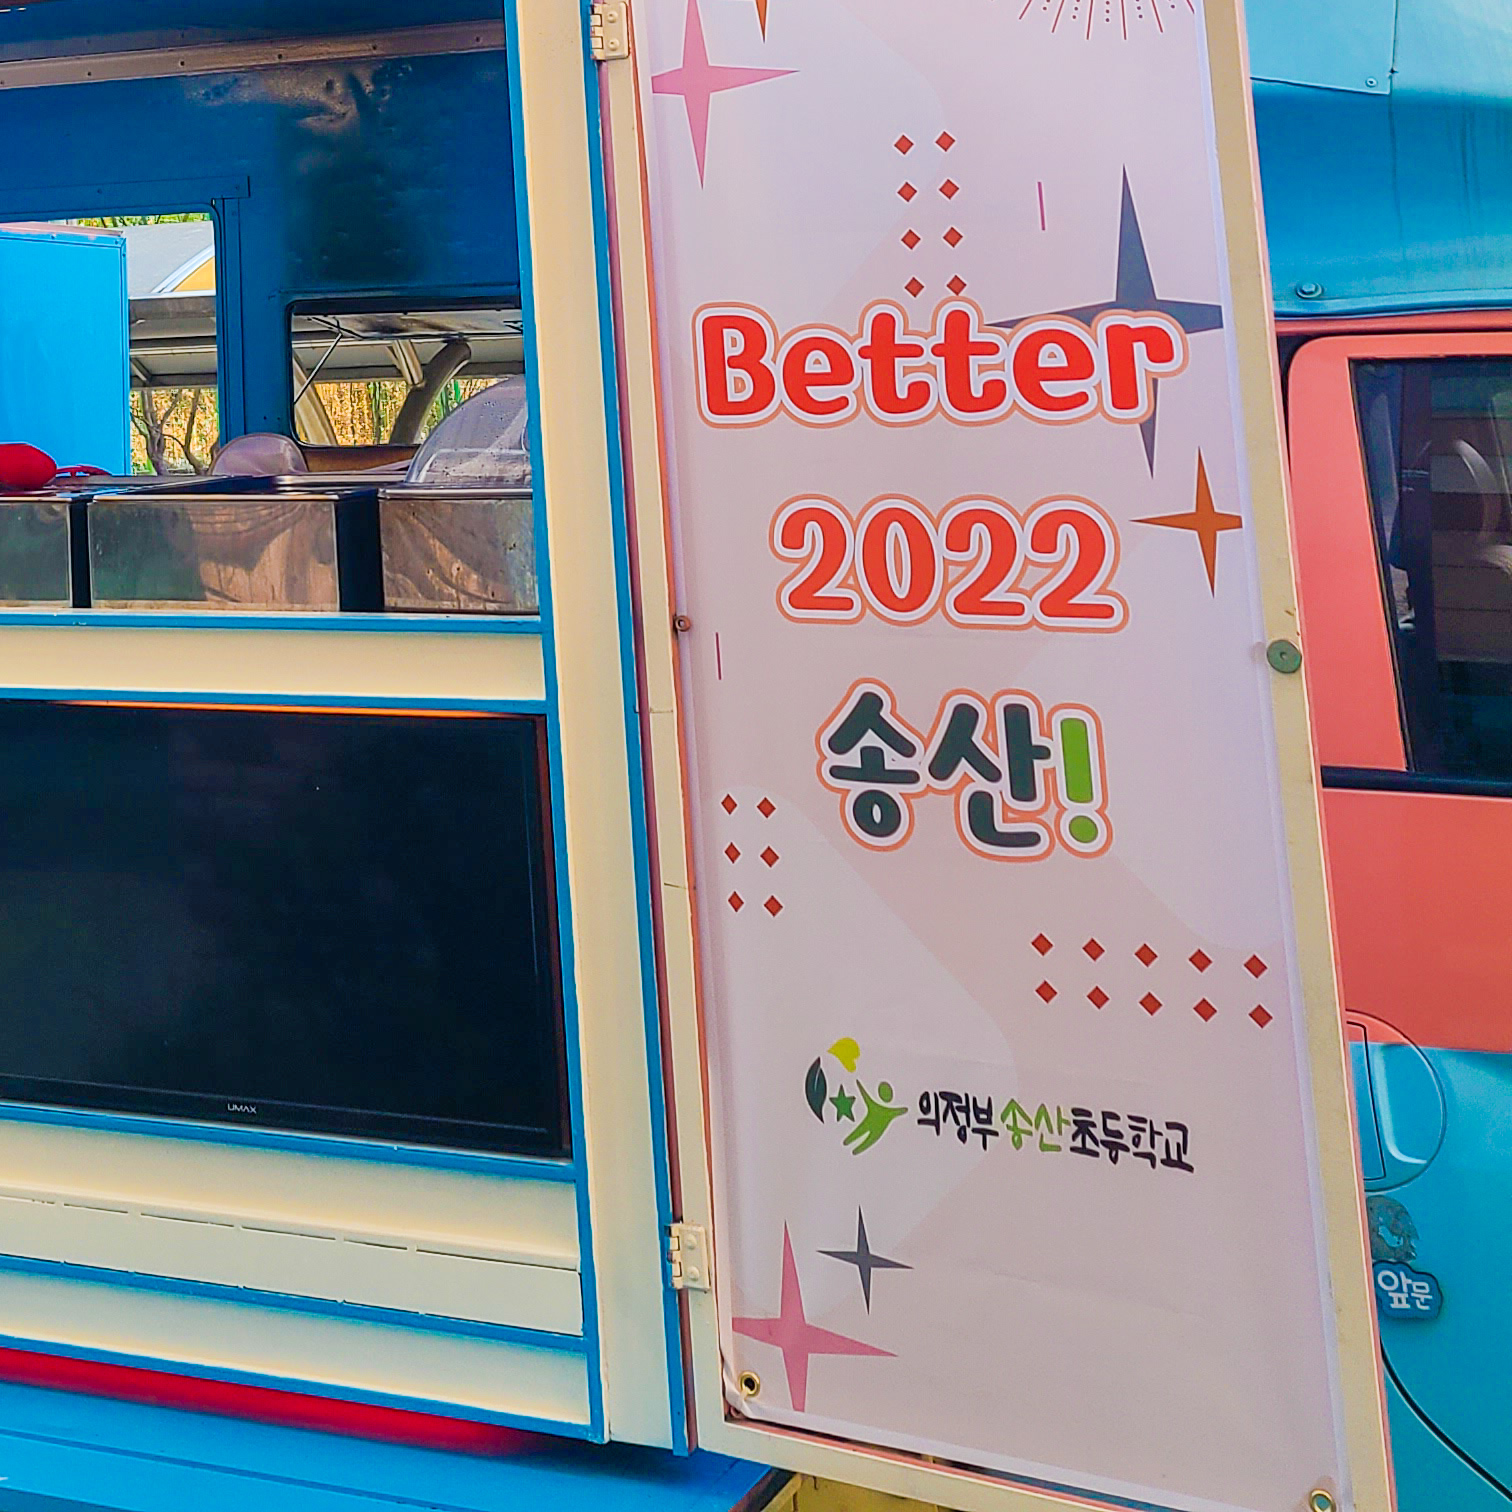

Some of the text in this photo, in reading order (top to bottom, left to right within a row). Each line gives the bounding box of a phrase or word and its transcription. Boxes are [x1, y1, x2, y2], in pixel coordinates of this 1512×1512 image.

[696, 301, 1184, 426] Better
[773, 498, 1125, 629] 2022
[819, 681, 1109, 857] 송산!
[227, 1103, 257, 1114] UMAX
[1377, 1270, 1432, 1310] 앞문
